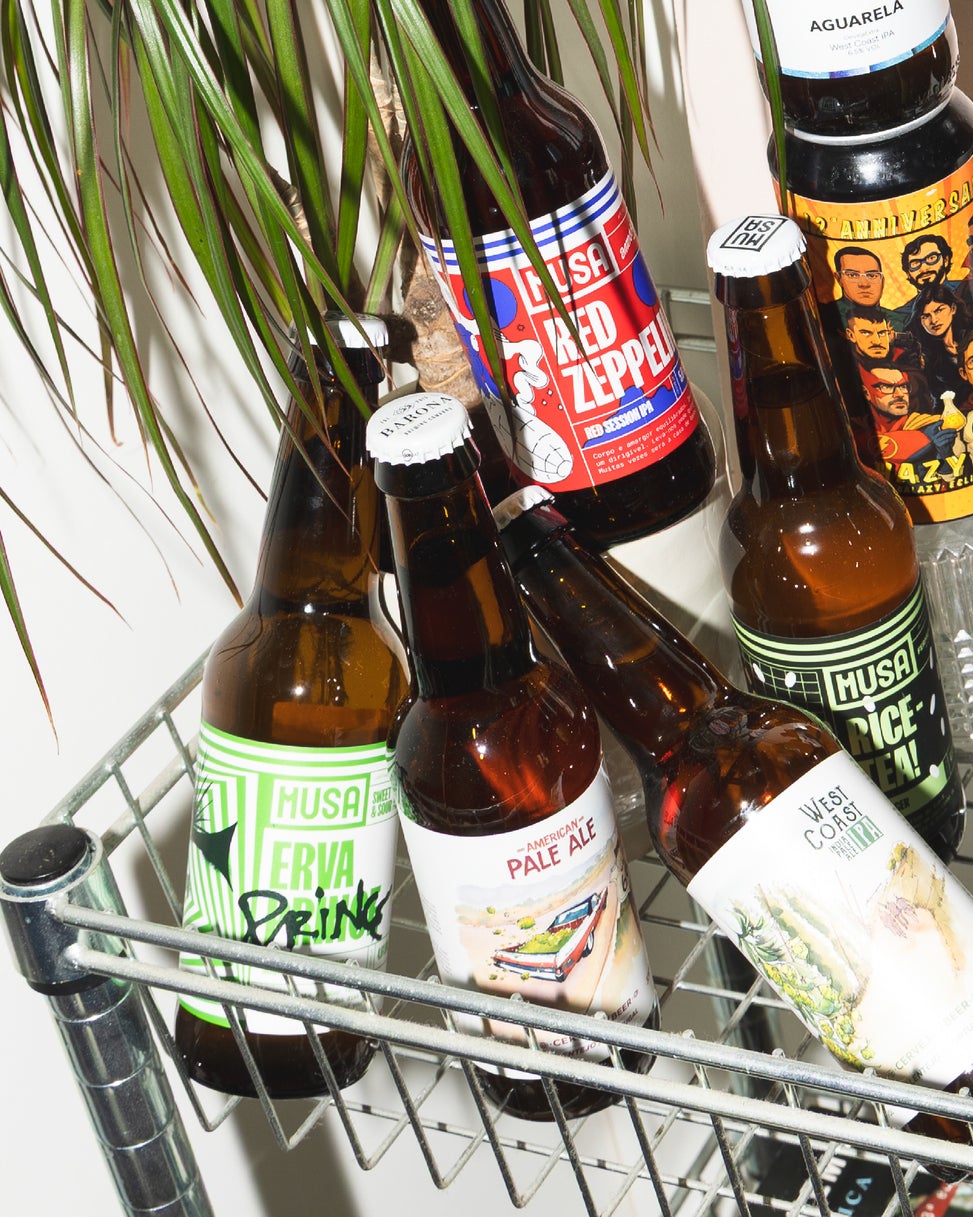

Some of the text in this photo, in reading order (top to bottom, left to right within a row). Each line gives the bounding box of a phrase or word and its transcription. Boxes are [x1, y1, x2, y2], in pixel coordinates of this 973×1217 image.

[810, 0, 904, 33] AGUARELA
[525, 241, 609, 304] MUSA
[543, 300, 616, 366] RED
[380, 396, 452, 438] BARONA
[584, 399, 655, 440] RED SESSION IPA
[592, 448, 615, 460] Corpo
[598, 462, 625, 474] Muitas
[627, 452, 648, 465] vezes
[835, 648, 912, 702] MUSA
[846, 693, 924, 757] RICE-
[859, 739, 922, 793] TEA!
[276, 785, 391, 820] MUSA SWEET
[799, 785, 849, 823] WEST
[527, 818, 579, 853] AMERICAN
[804, 801, 863, 850] COAST
[847, 817, 880, 851] IPA
[269, 840, 354, 891] ERVA
[506, 816, 597, 880] PALE ALE
[611, 997, 632, 1021] BEER
